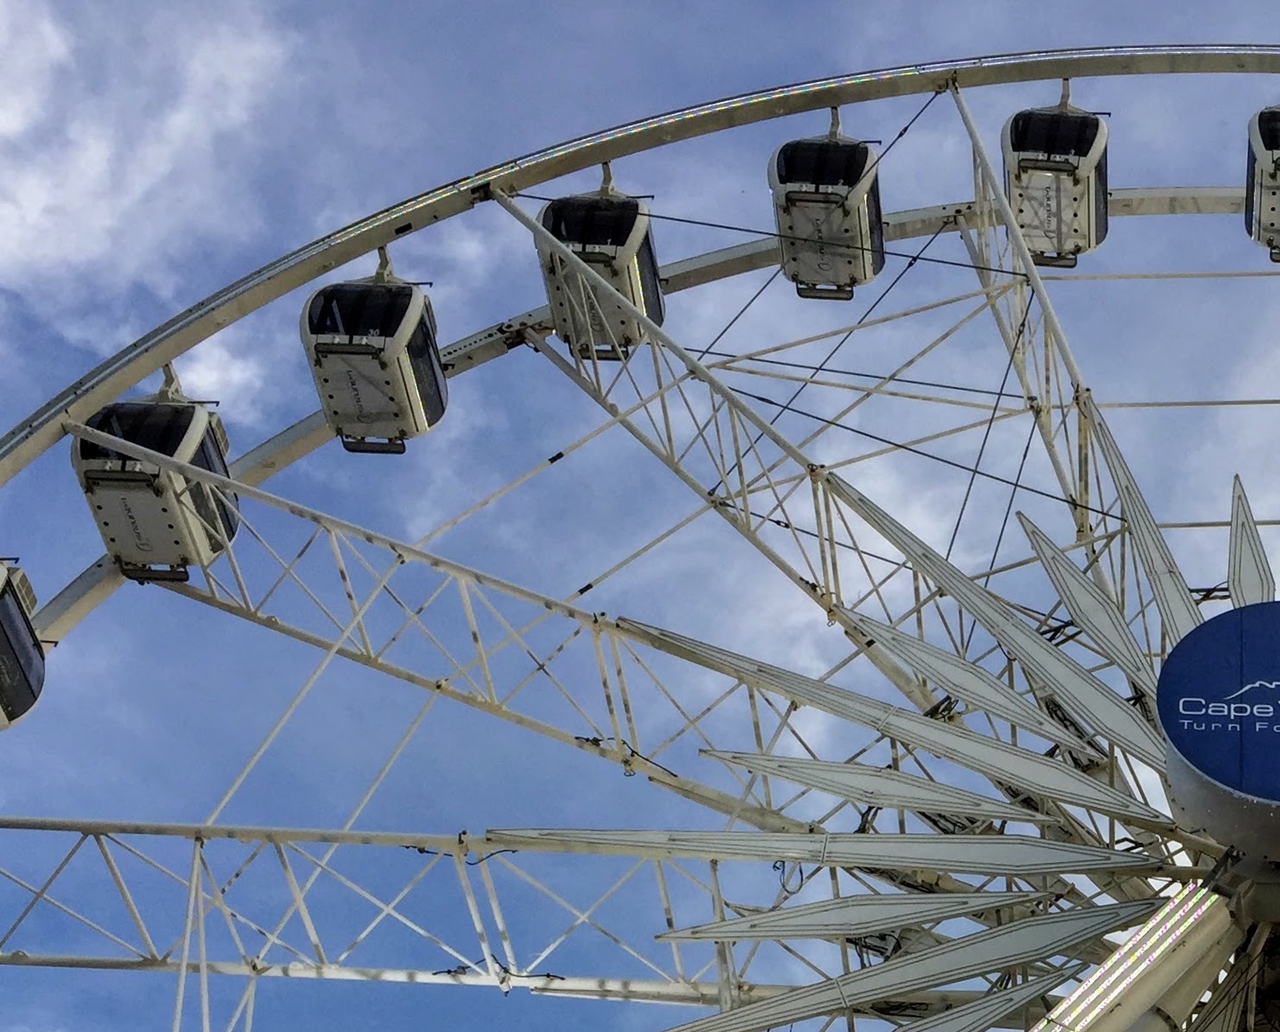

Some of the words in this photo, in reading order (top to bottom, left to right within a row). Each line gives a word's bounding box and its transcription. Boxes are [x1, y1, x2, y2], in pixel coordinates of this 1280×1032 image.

[368, 328, 380, 337] 30
[1178, 697, 1274, 720] Cape
[1178, 719, 1241, 732] Turn
